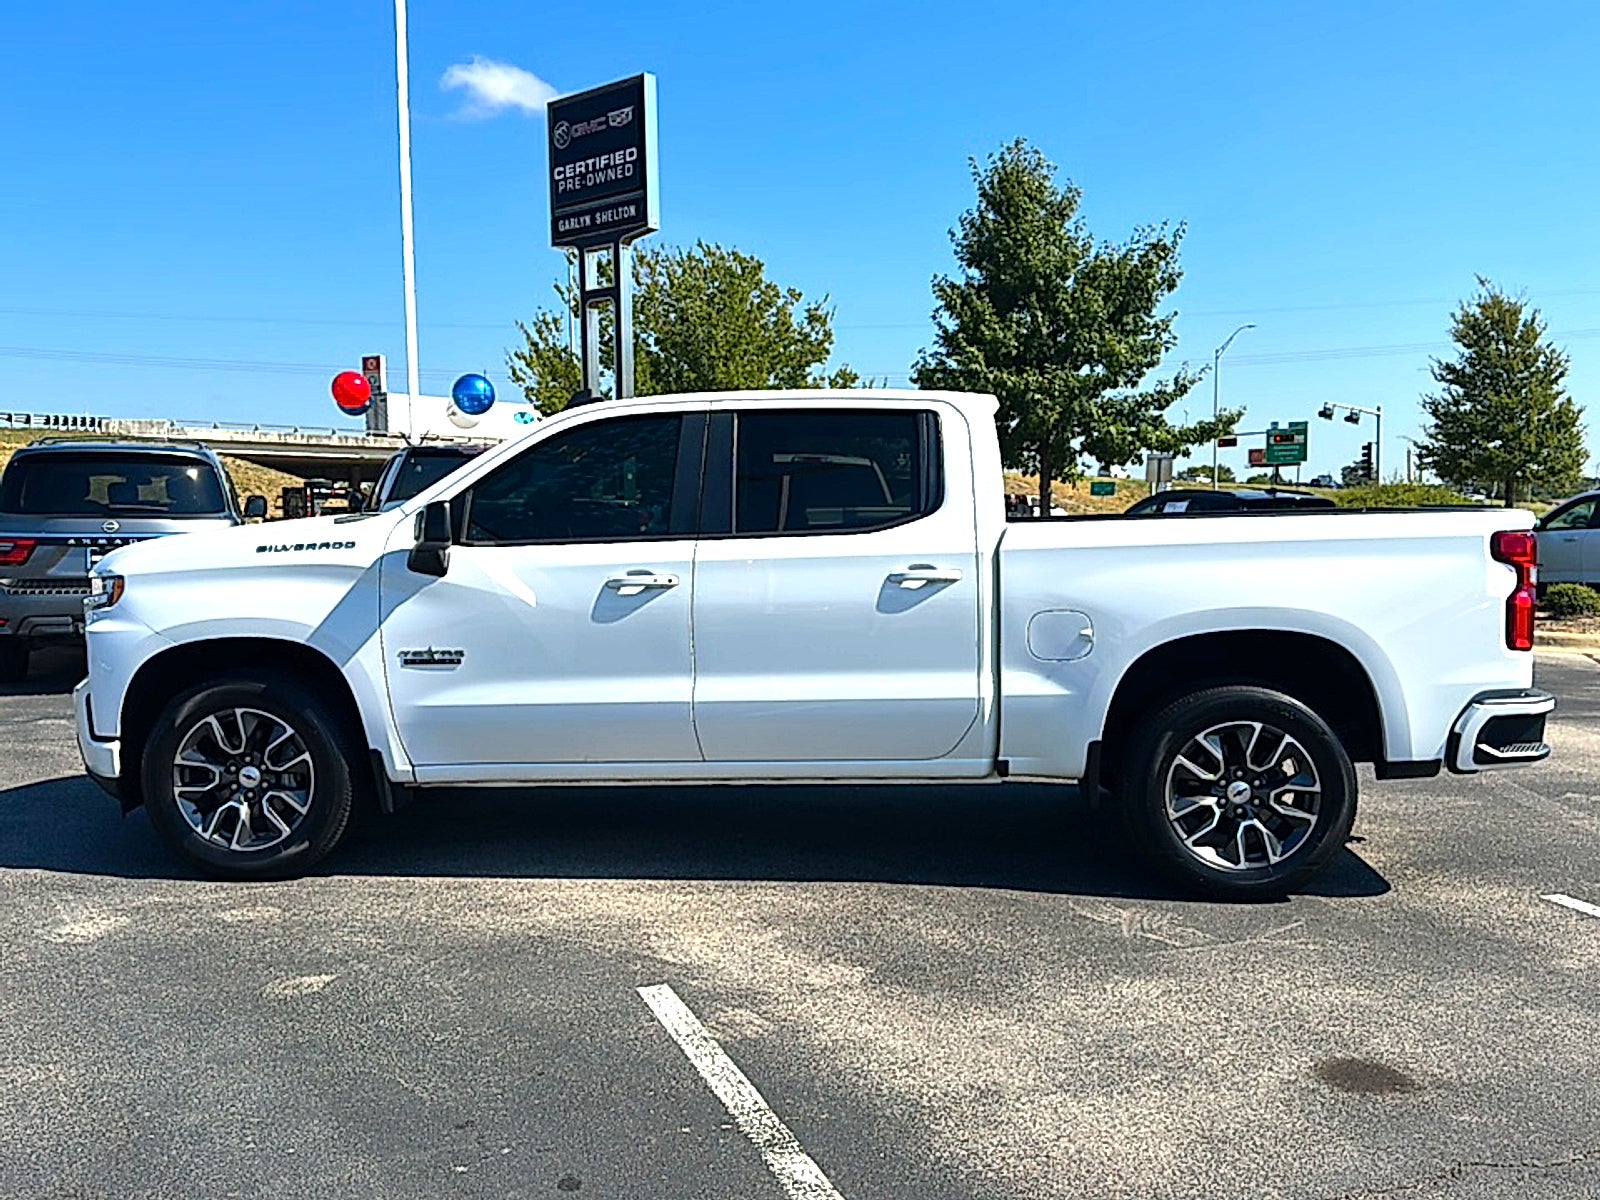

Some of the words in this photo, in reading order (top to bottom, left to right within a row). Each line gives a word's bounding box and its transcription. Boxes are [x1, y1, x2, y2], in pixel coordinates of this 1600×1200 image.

[571, 116, 607, 138] GMC
[554, 147, 638, 179] CERTIFIED
[558, 164, 634, 193] PRE-OWNED
[558, 214, 591, 232] GARLYN
[595, 205, 637, 225] SHELTON
[256, 541, 356, 553] SILVERADO
